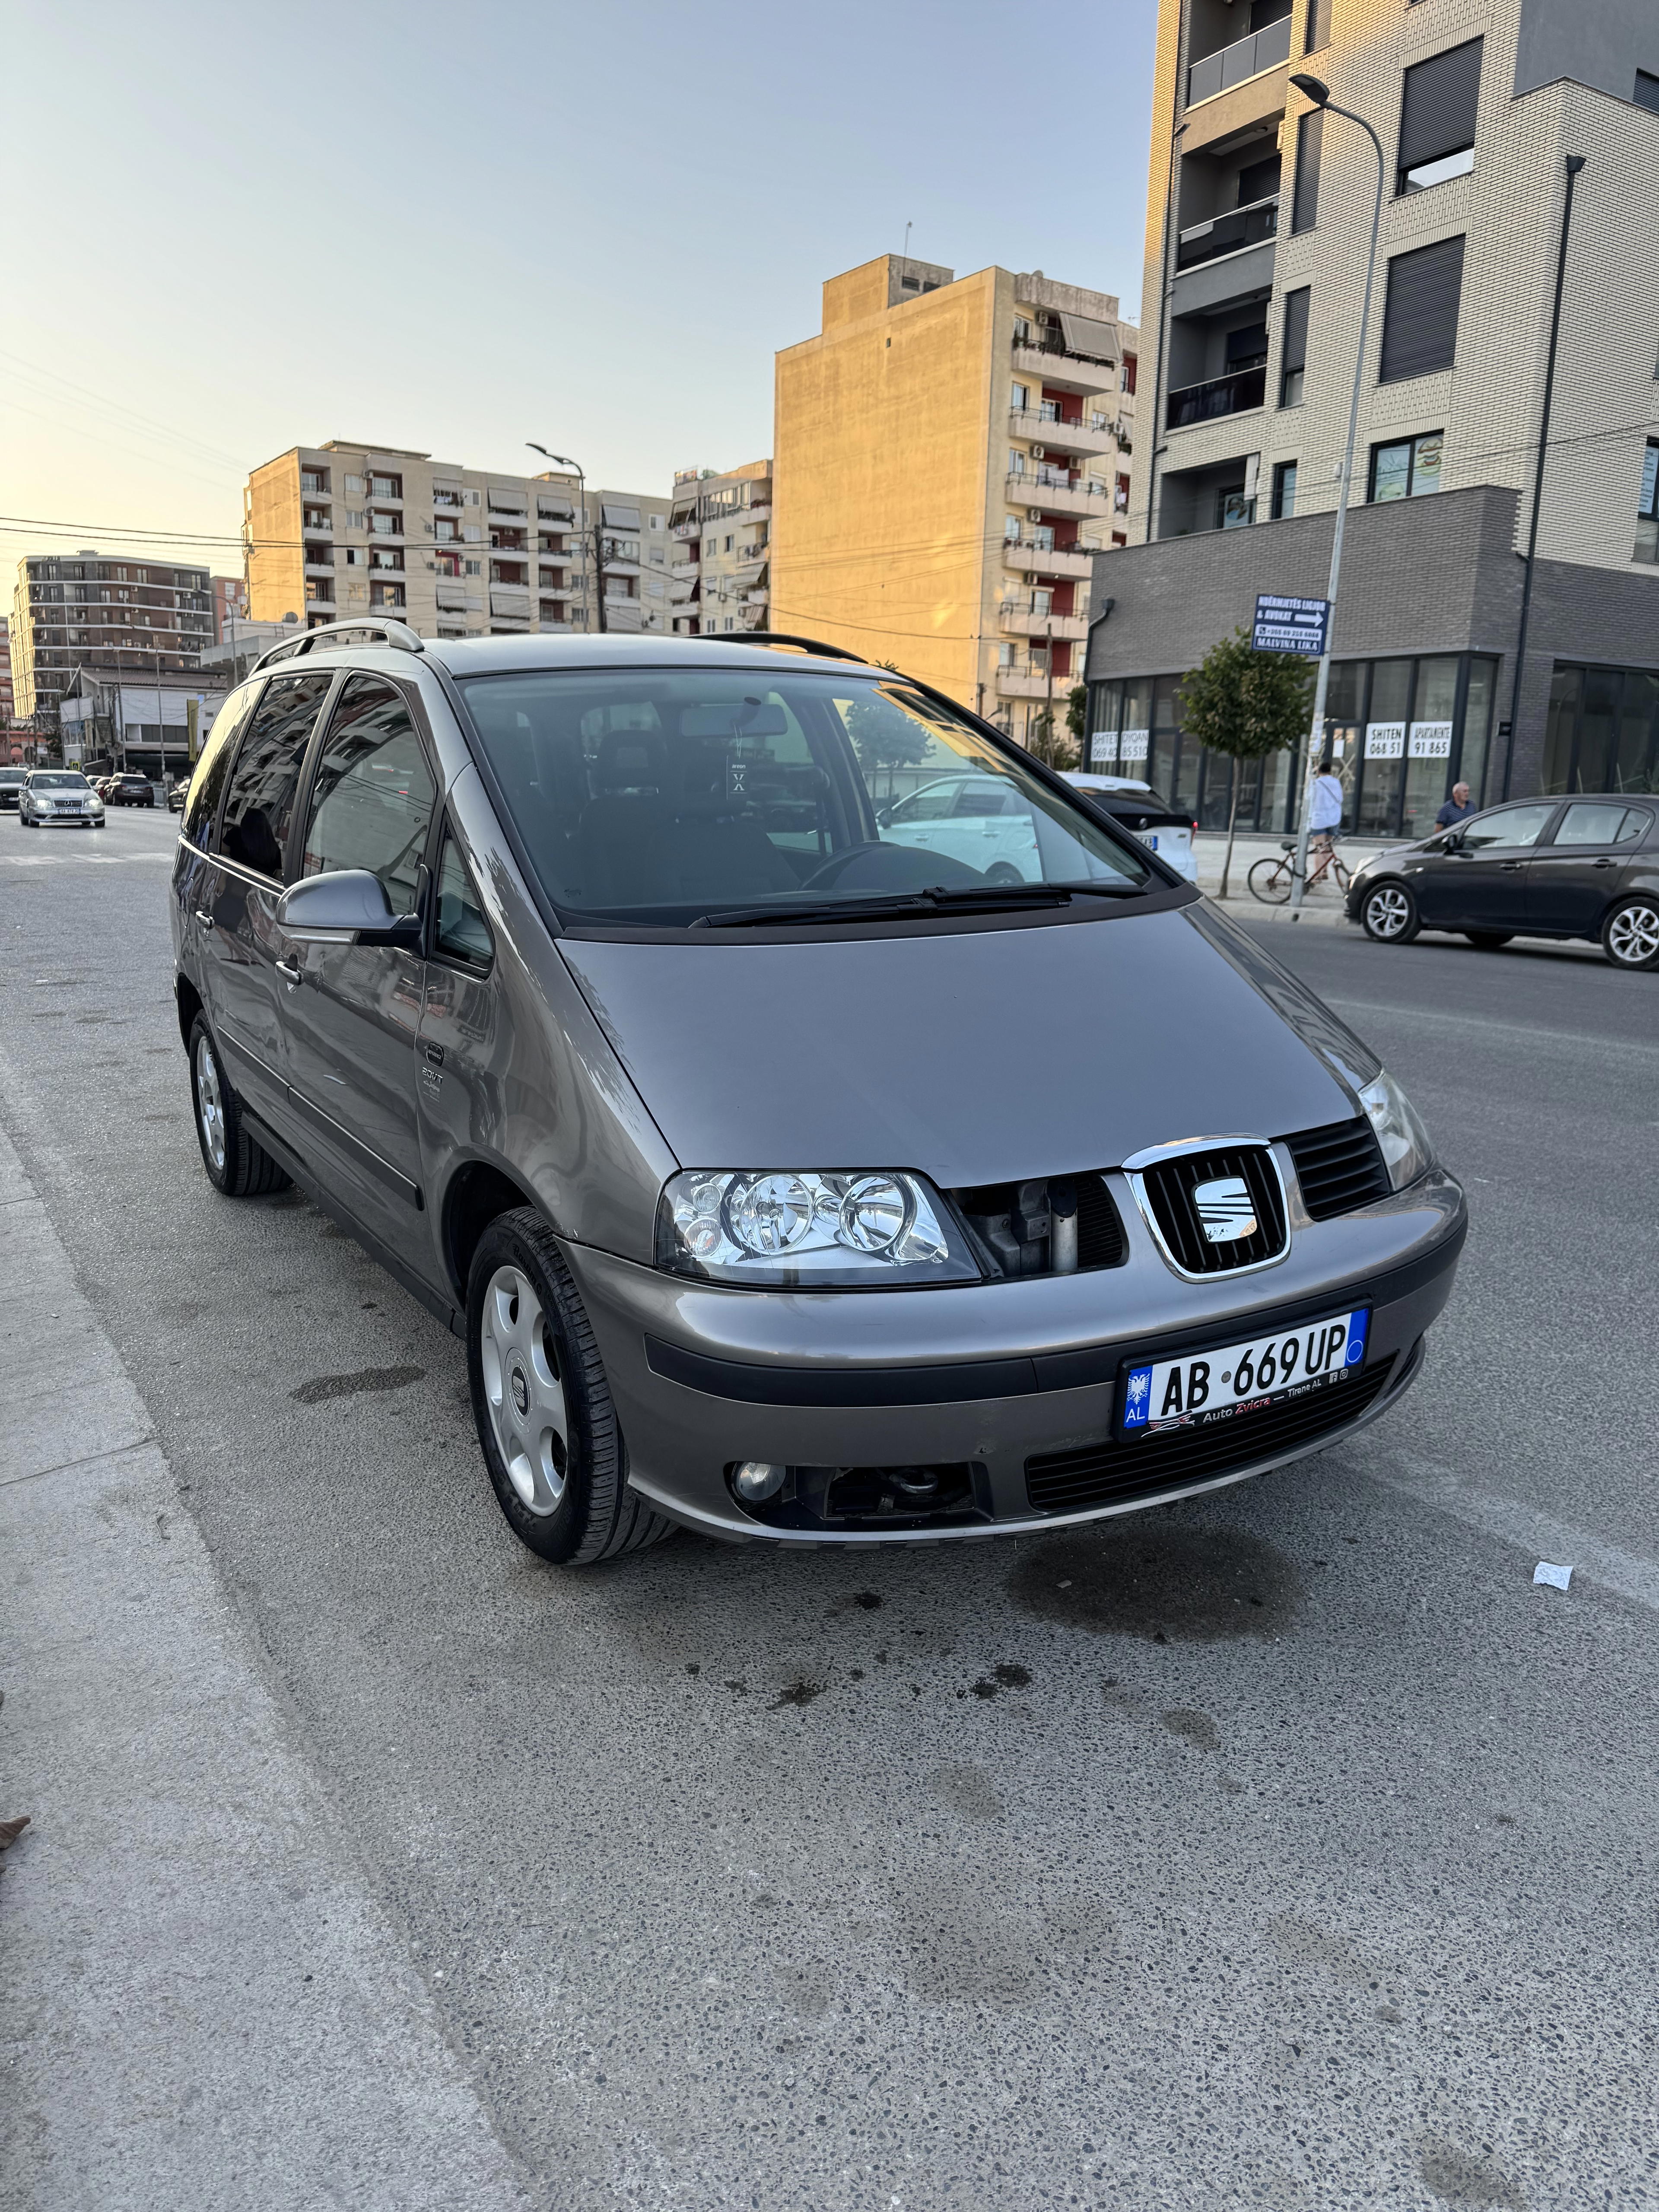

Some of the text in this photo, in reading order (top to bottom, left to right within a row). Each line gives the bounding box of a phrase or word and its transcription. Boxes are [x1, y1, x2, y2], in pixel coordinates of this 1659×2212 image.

[1257, 637, 1318, 651] MALVINA LIKA
[1372, 728, 1402, 741] SHITEN
[1370, 741, 1447, 754] 068 51 91 865
[1161, 1324, 1346, 1416] AB 669 UP
[1202, 1408, 1233, 1423] Auto
[1235, 1397, 1271, 1415] Zvicra
[1312, 1379, 1322, 1390] AL
[1125, 1408, 1145, 1423] AL
